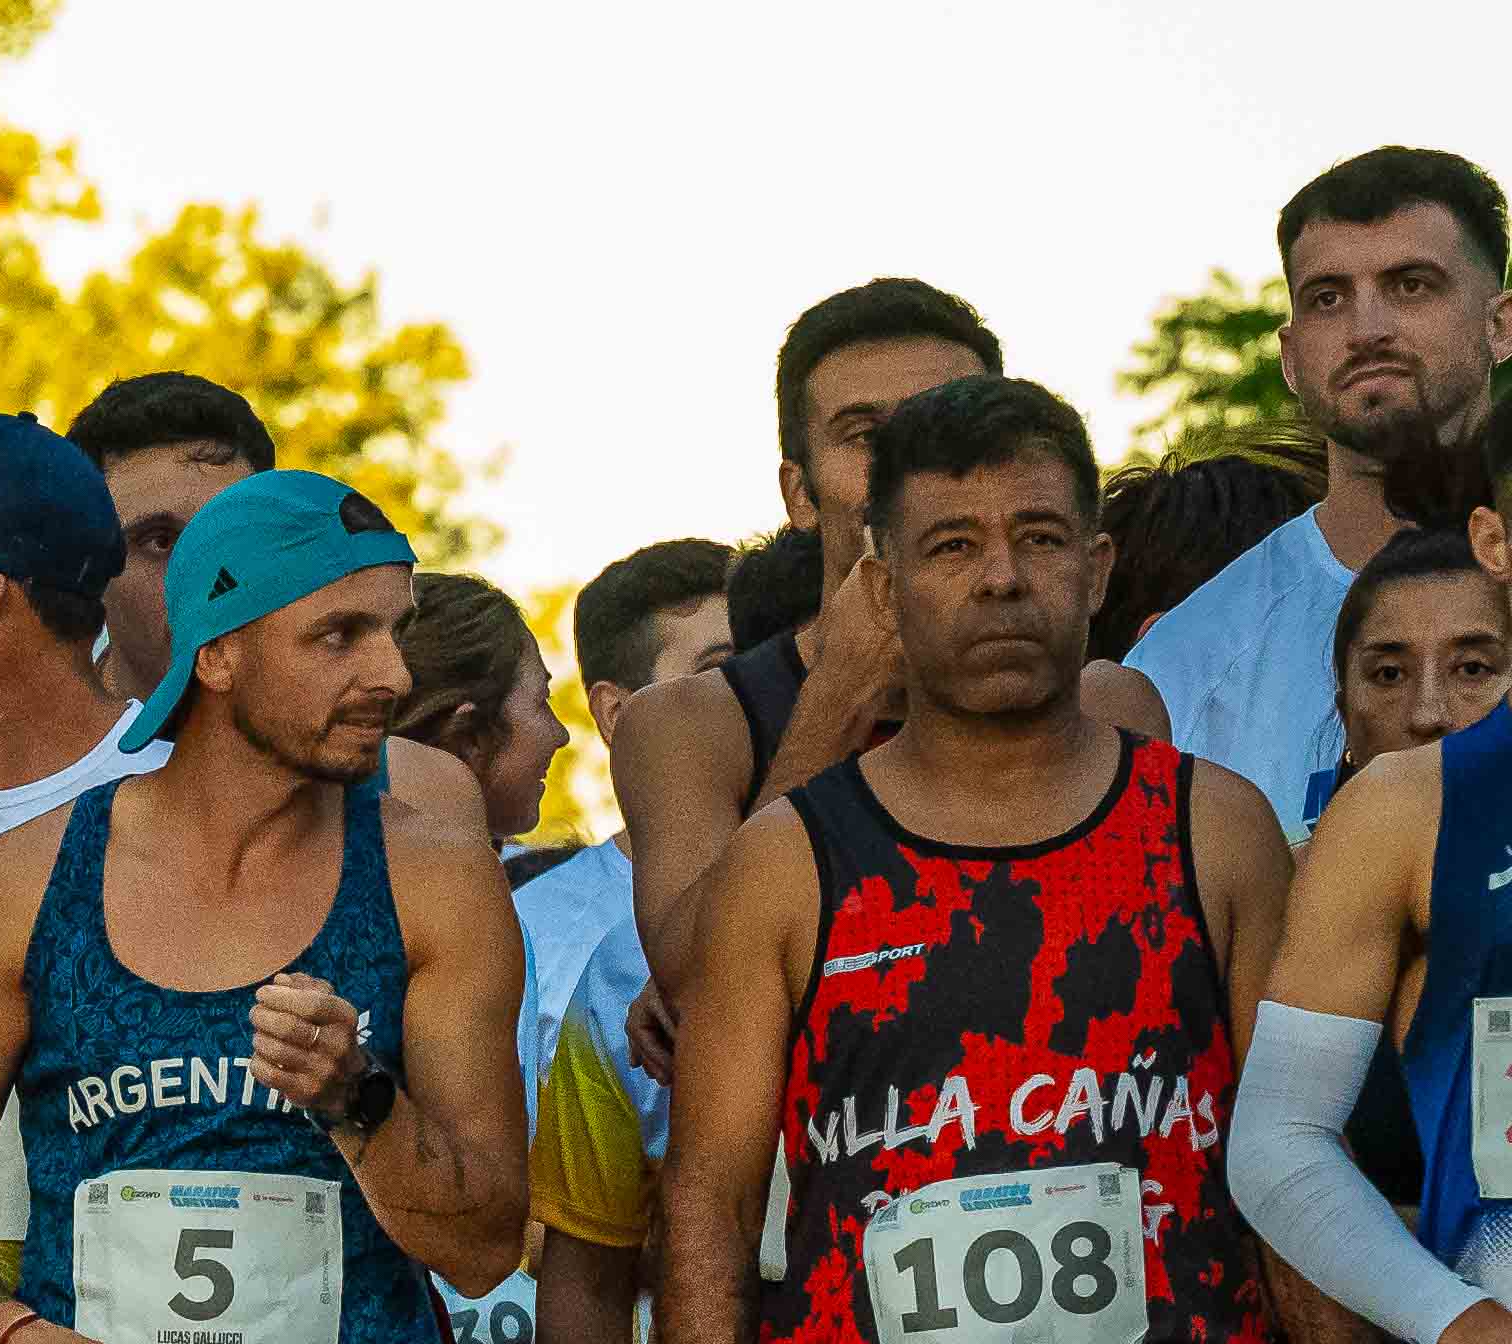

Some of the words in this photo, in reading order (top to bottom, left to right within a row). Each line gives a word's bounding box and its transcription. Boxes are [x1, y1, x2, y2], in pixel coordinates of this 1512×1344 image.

[66, 1056, 309, 1135] ARGENT
[1010, 1051, 1221, 1152] CAÑAS
[167, 1229, 235, 1322] 5
[893, 1220, 1118, 1335] 108
[156, 1329, 192, 1344] LUCAS
